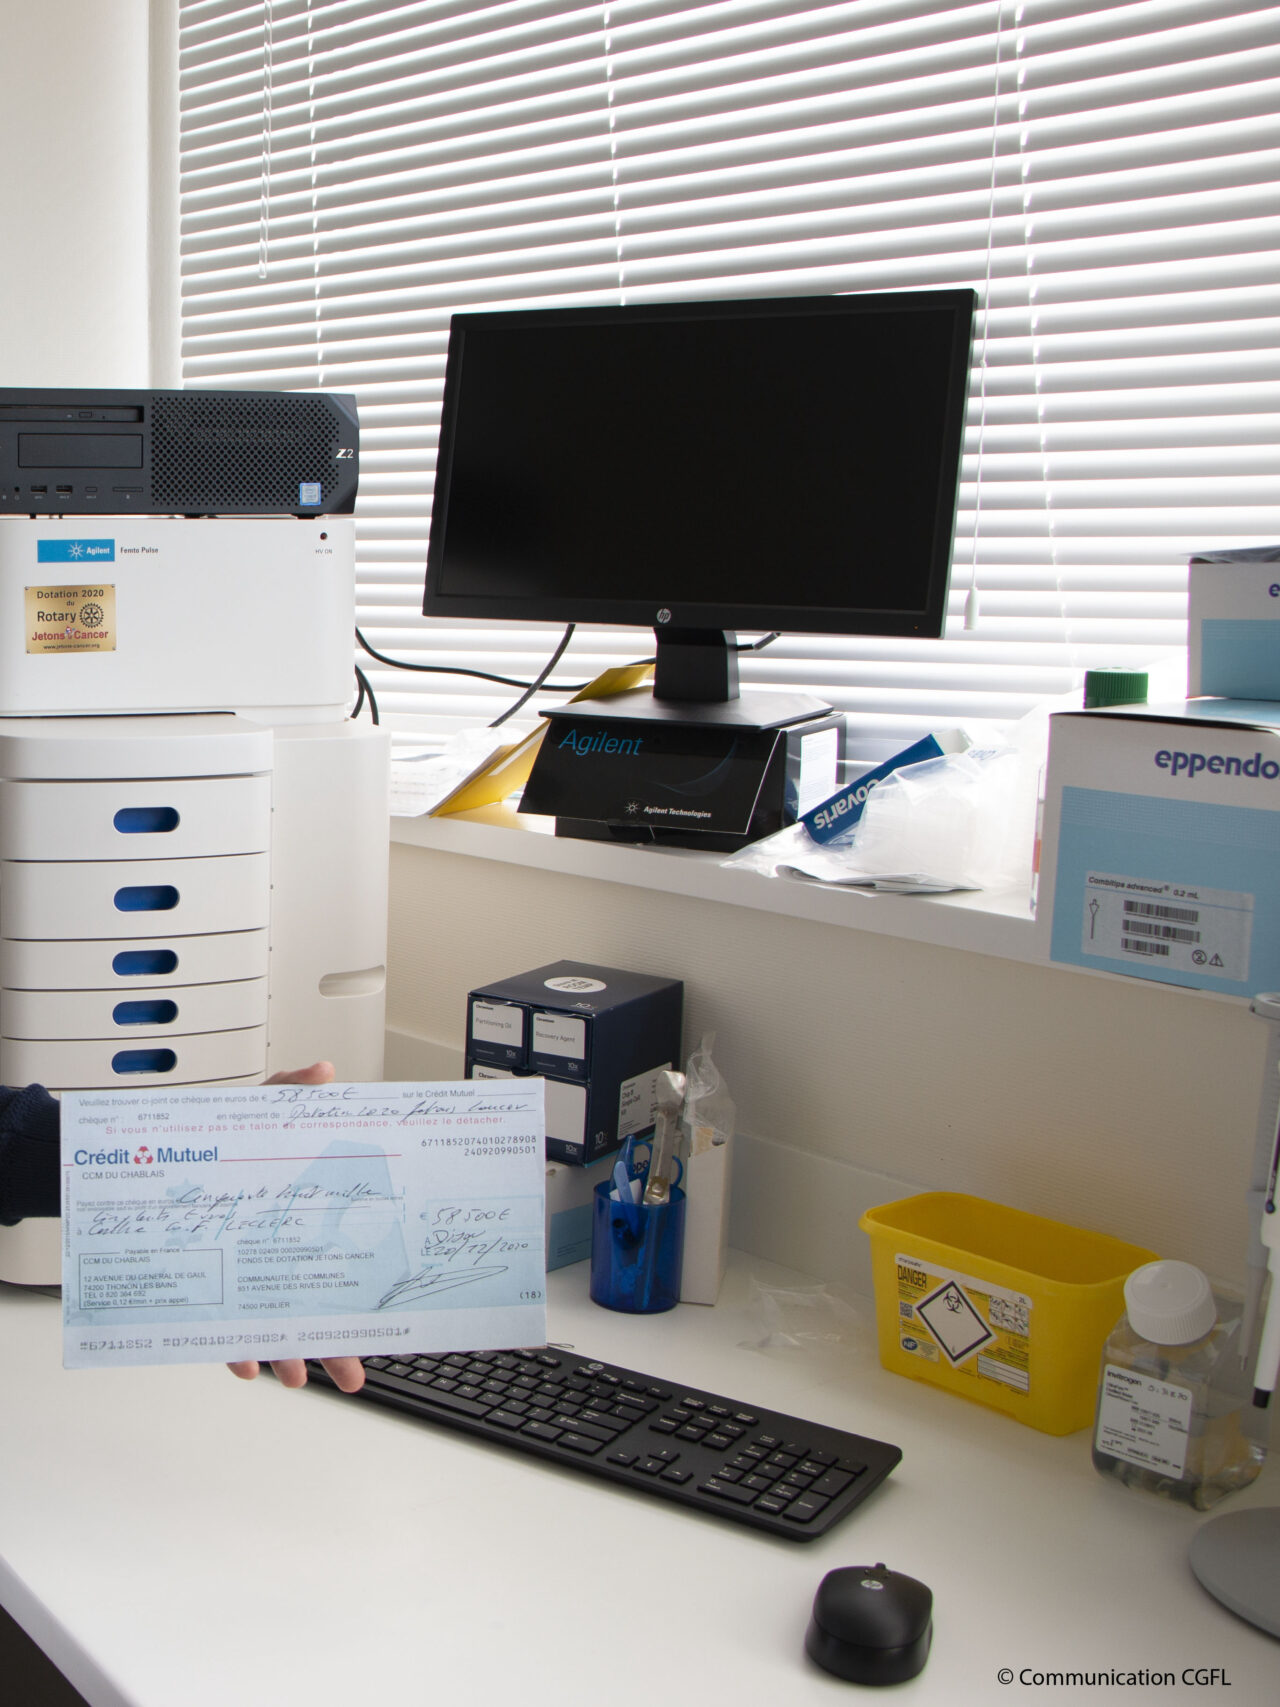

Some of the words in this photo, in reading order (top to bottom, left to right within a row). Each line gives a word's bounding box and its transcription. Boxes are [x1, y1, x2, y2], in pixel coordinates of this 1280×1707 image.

[336, 448, 354, 459] Z2
[86, 547, 110, 555] Agilent
[37, 590, 78, 599] Dotation
[82, 589, 104, 598] 2020
[37, 610, 76, 623] Rotary
[32, 631, 65, 641] Jetons
[74, 630, 108, 640] Cancer
[558, 728, 643, 756] Agilent
[644, 805, 667, 815] Agilent
[669, 808, 712, 819] Technologies
[1088, 876, 1125, 888] Combitips
[536, 1031, 560, 1041] Recovery
[560, 1035, 575, 1043] Agent
[402, 1091, 414, 1099] sur
[415, 1090, 423, 1098] le
[425, 1089, 448, 1098] Crédit
[450, 1088, 475, 1098] Mutuel
[78, 1098, 110, 1107] Veuillez
[112, 1098, 139, 1106] trouver
[181, 1096, 210, 1105] chèque
[249, 1095, 259, 1103] de
[78, 1116, 108, 1126] chèque
[138, 1112, 170, 1122] 6711852
[229, 1112, 268, 1121] règlement
[270, 1112, 280, 1120] de
[106, 1126, 117, 1135] Si
[122, 1126, 147, 1134] vous
[152, 1124, 203, 1133] n'utilisez
[208, 1124, 228, 1133] pas
[233, 1124, 246, 1132] ce
[250, 1122, 278, 1130] talon
[283, 1120, 296, 1130] de
[300, 1119, 393, 1130] correspondance,
[397, 1116, 438, 1126] veuillez
[443, 1116, 452, 1125] le
[457, 1115, 506, 1125] détacher.
[421, 1135, 537, 1148] 6711852074010278908
[74, 1149, 130, 1166] Crédit
[157, 1146, 218, 1163] Mutuel
[464, 1146, 537, 1157] 240920990501
[82, 1171, 103, 1180] CCM
[105, 1171, 119, 1179] DU
[120, 1170, 165, 1179] CHABLAIS
[432, 1207, 462, 1226] 58
[225, 1217, 305, 1231] LECLERC
[237, 1256, 263, 1264] FONDS
[264, 1256, 275, 1264] DE
[276, 1254, 314, 1263] DOTATION
[315, 1253, 344, 1261] JETONS
[345, 1252, 375, 1260] CANCER
[421, 1249, 431, 1257] LE
[83, 1257, 101, 1265] CCM
[114, 1255, 151, 1264] CHABLAIS
[94, 1274, 125, 1282] AVENUE
[125, 1273, 137, 1281] DU
[138, 1272, 173, 1280] GENERAL
[237, 1273, 289, 1283] COMMUNAUTE
[291, 1273, 301, 1281] DE
[303, 1272, 345, 1281] COMMUNES
[897, 1265, 928, 1289] DANGER
[84, 1284, 104, 1292] 74200
[106, 1283, 138, 1291] THONON
[140, 1282, 154, 1290] LES
[155, 1281, 178, 1289] BAINS
[251, 1283, 281, 1292] AVENUE
[282, 1282, 298, 1290] DES
[299, 1281, 321, 1289] RIVES
[323, 1281, 333, 1289] DU
[334, 1280, 359, 1288] LEMAN
[520, 1291, 542, 1300] (18)
[259, 1301, 291, 1310] PUBLIER
